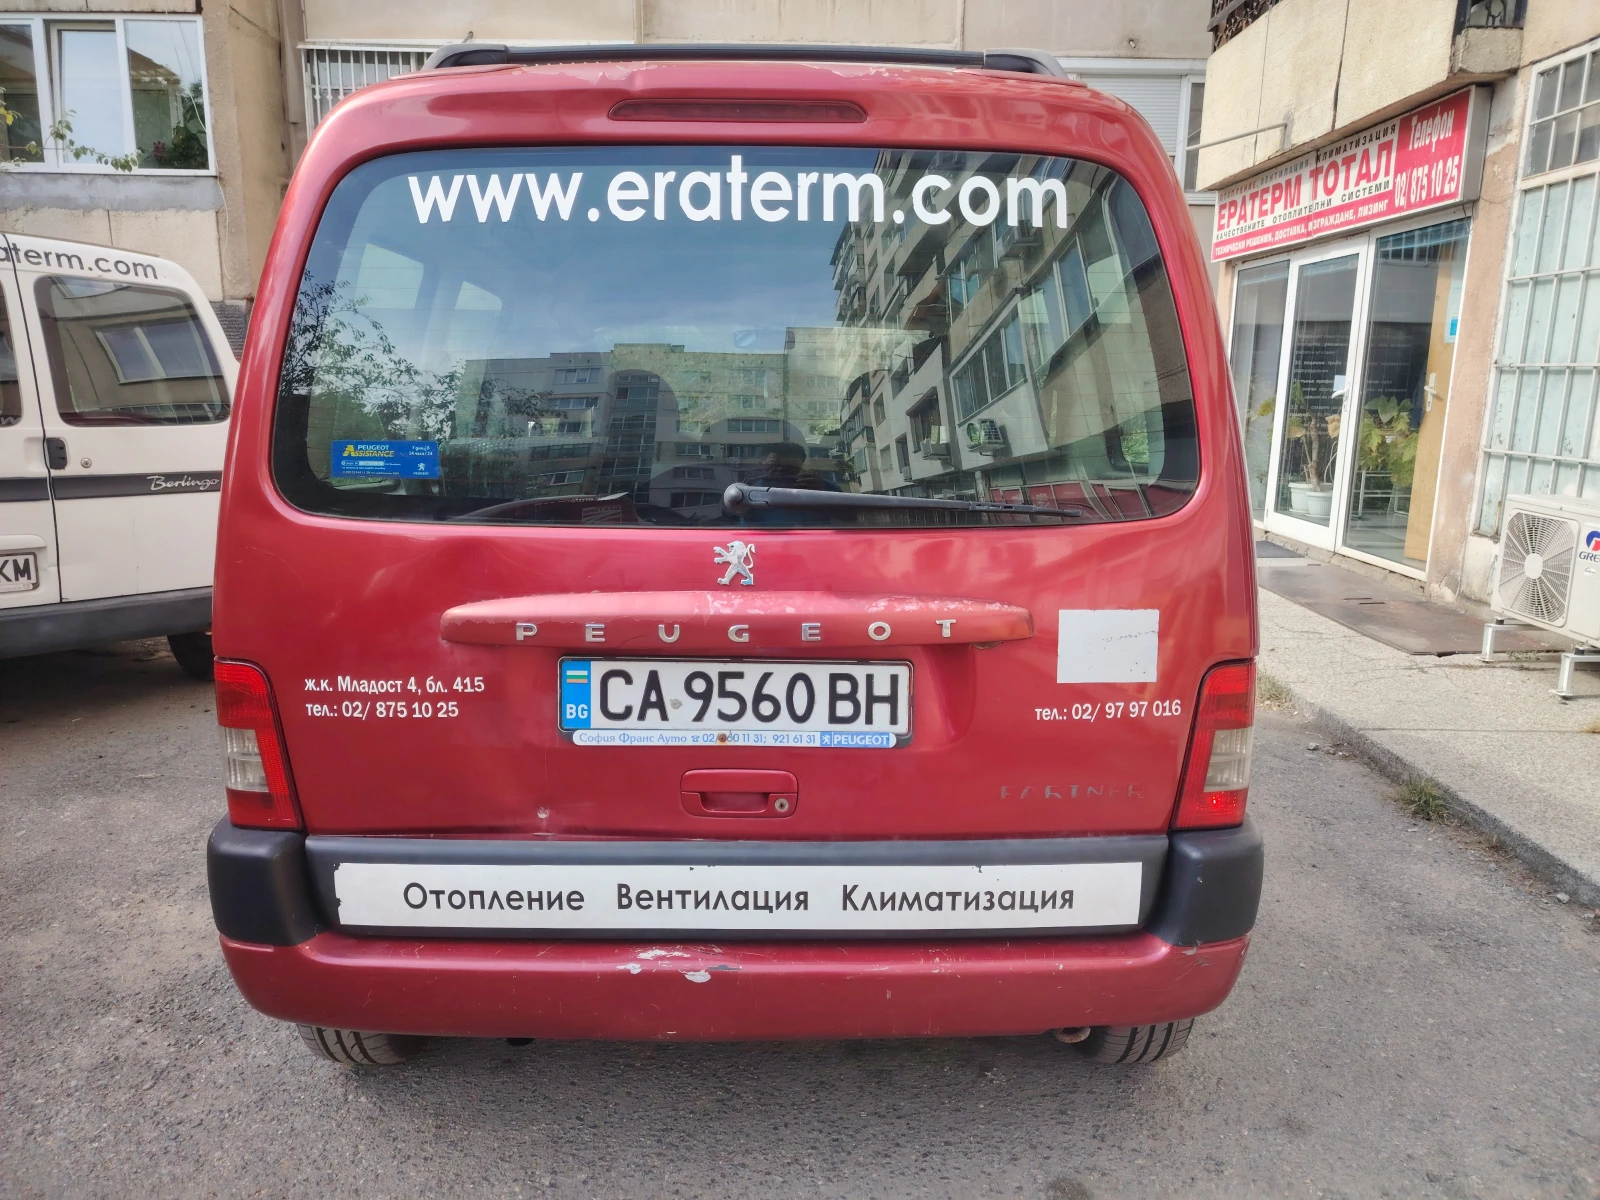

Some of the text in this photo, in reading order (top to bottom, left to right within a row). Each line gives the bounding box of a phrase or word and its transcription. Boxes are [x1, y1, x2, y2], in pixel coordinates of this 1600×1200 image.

[1409, 105, 1455, 152] Телефон
[1316, 124, 1396, 163] КЛИМАТИЗАЦИЯ
[408, 155, 1067, 228] www.eraterm.com
[1217, 139, 1393, 232] ЕРАТЕРМ ТОТАЛ
[1410, 165, 1428, 204] 875
[1431, 159, 1443, 197] 10
[1444, 155, 1459, 194] 25
[1216, 180, 1389, 240] КАЧЕСТВЕНИТЕ ОТОПЛИТЕЛНИ СИСТЕМИ
[1215, 240, 1246, 256] ТЕХНИЧЕСКИ
[1275, 223, 1307, 242] ДОСТАВКА,
[1308, 210, 1356, 232] ИЗГРАЖДАНЕ,
[1358, 199, 1388, 218] ЛИЗИНГ
[342, 444, 395, 457] ASSISTANCE
[146, 475, 220, 490] Berlingo
[1579, 551, 1600, 563] GRE
[515, 619, 958, 643] PEUGEOT
[304, 675, 485, 696] ж.к. Младост 4, бл. 415
[599, 669, 899, 726] CA 9560 BH
[305, 701, 459, 721] тел.: 02/ 875 10 25
[566, 703, 588, 719] BG
[1034, 699, 1182, 723] тел.: 02/ 97 97 016
[579, 732, 616, 744] София
[618, 732, 655, 745] Франс
[702, 733, 740, 745] 02/60
[742, 733, 750, 744] 11
[753, 733, 767, 745] 31;
[772, 734, 790, 744] 921
[793, 734, 803, 744] 61
[806, 734, 816, 744] 31
[833, 734, 889, 746] PEUGEOT
[403, 882, 1074, 914] Отопление Вентилация Климатизация
